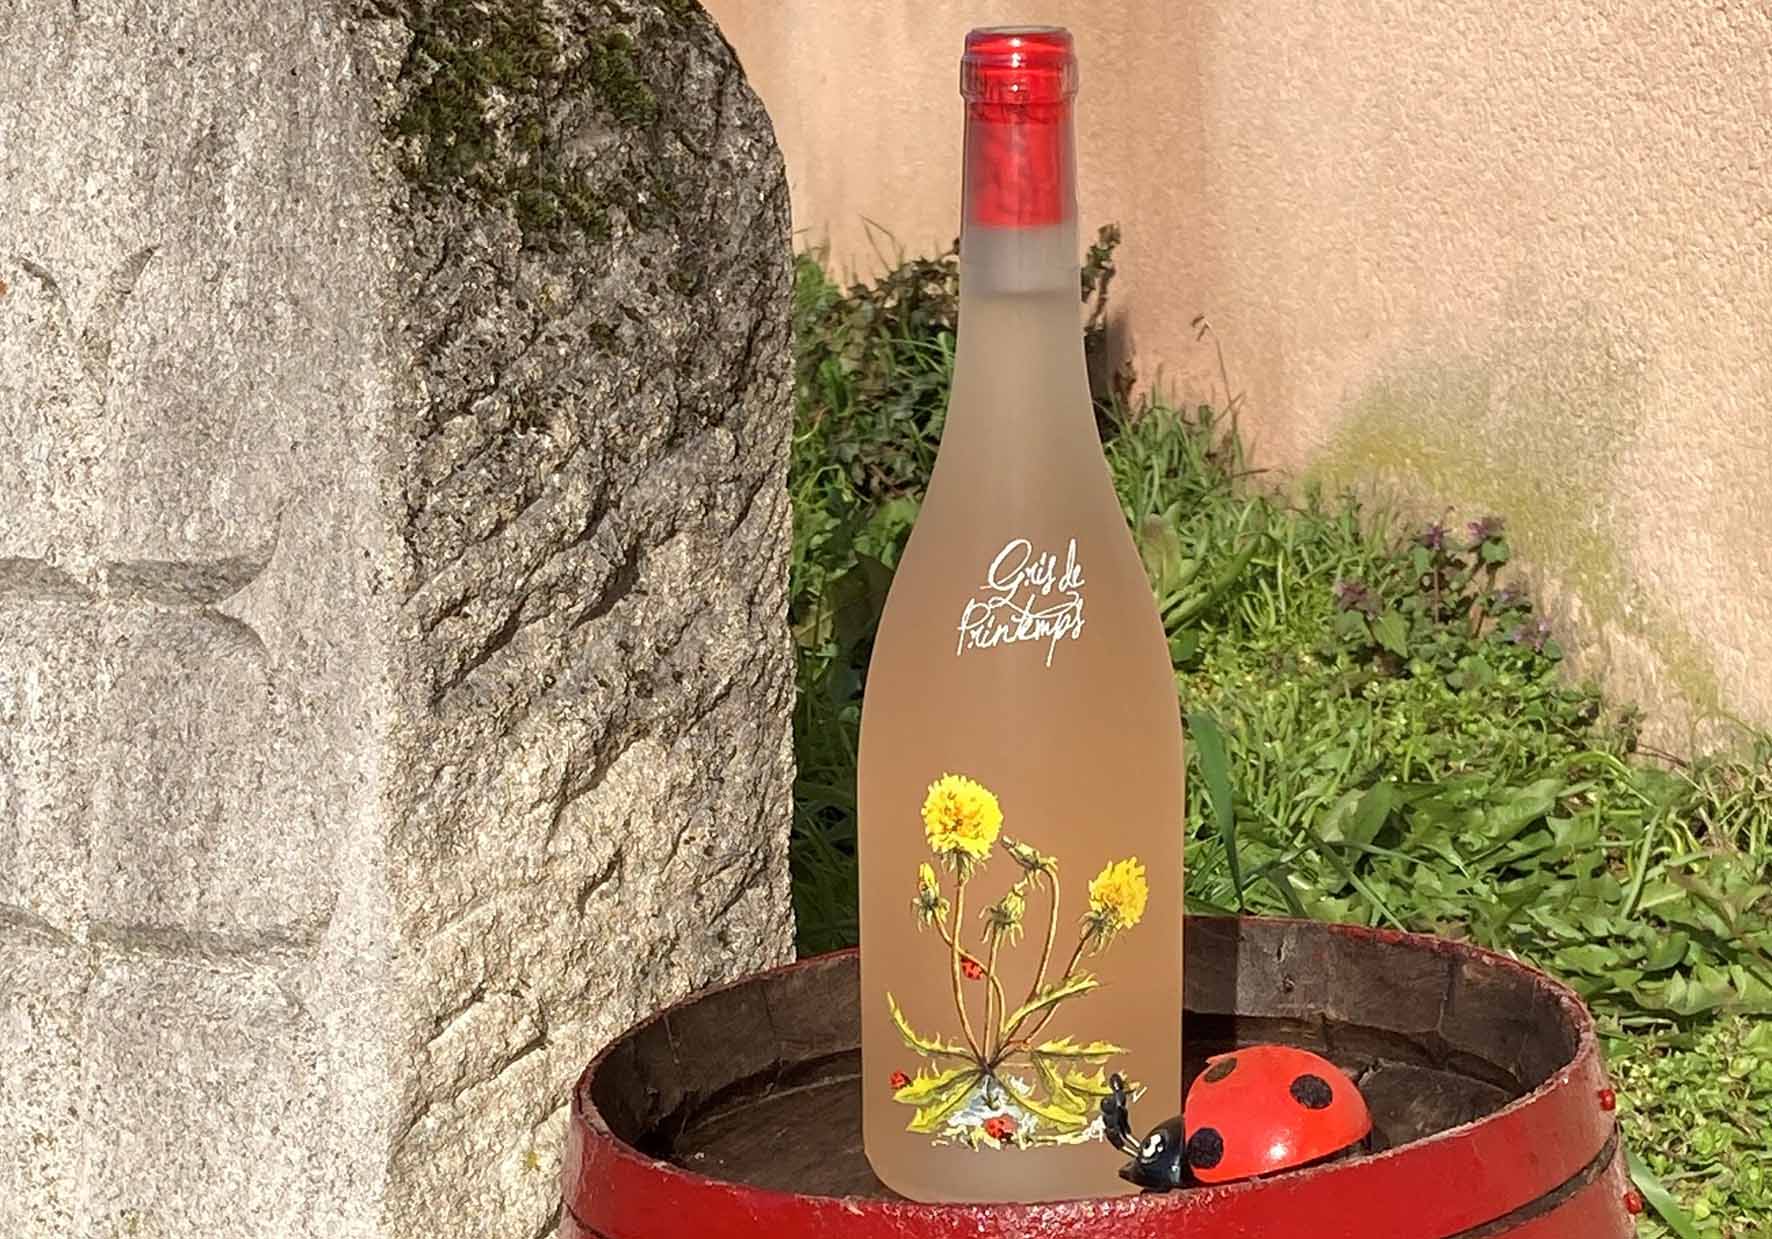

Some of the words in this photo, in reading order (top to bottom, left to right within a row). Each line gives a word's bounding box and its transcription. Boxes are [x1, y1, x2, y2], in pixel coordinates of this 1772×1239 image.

[981, 538, 1056, 601] Gris
[1058, 538, 1085, 592] de
[957, 594, 1085, 667] Printemps
